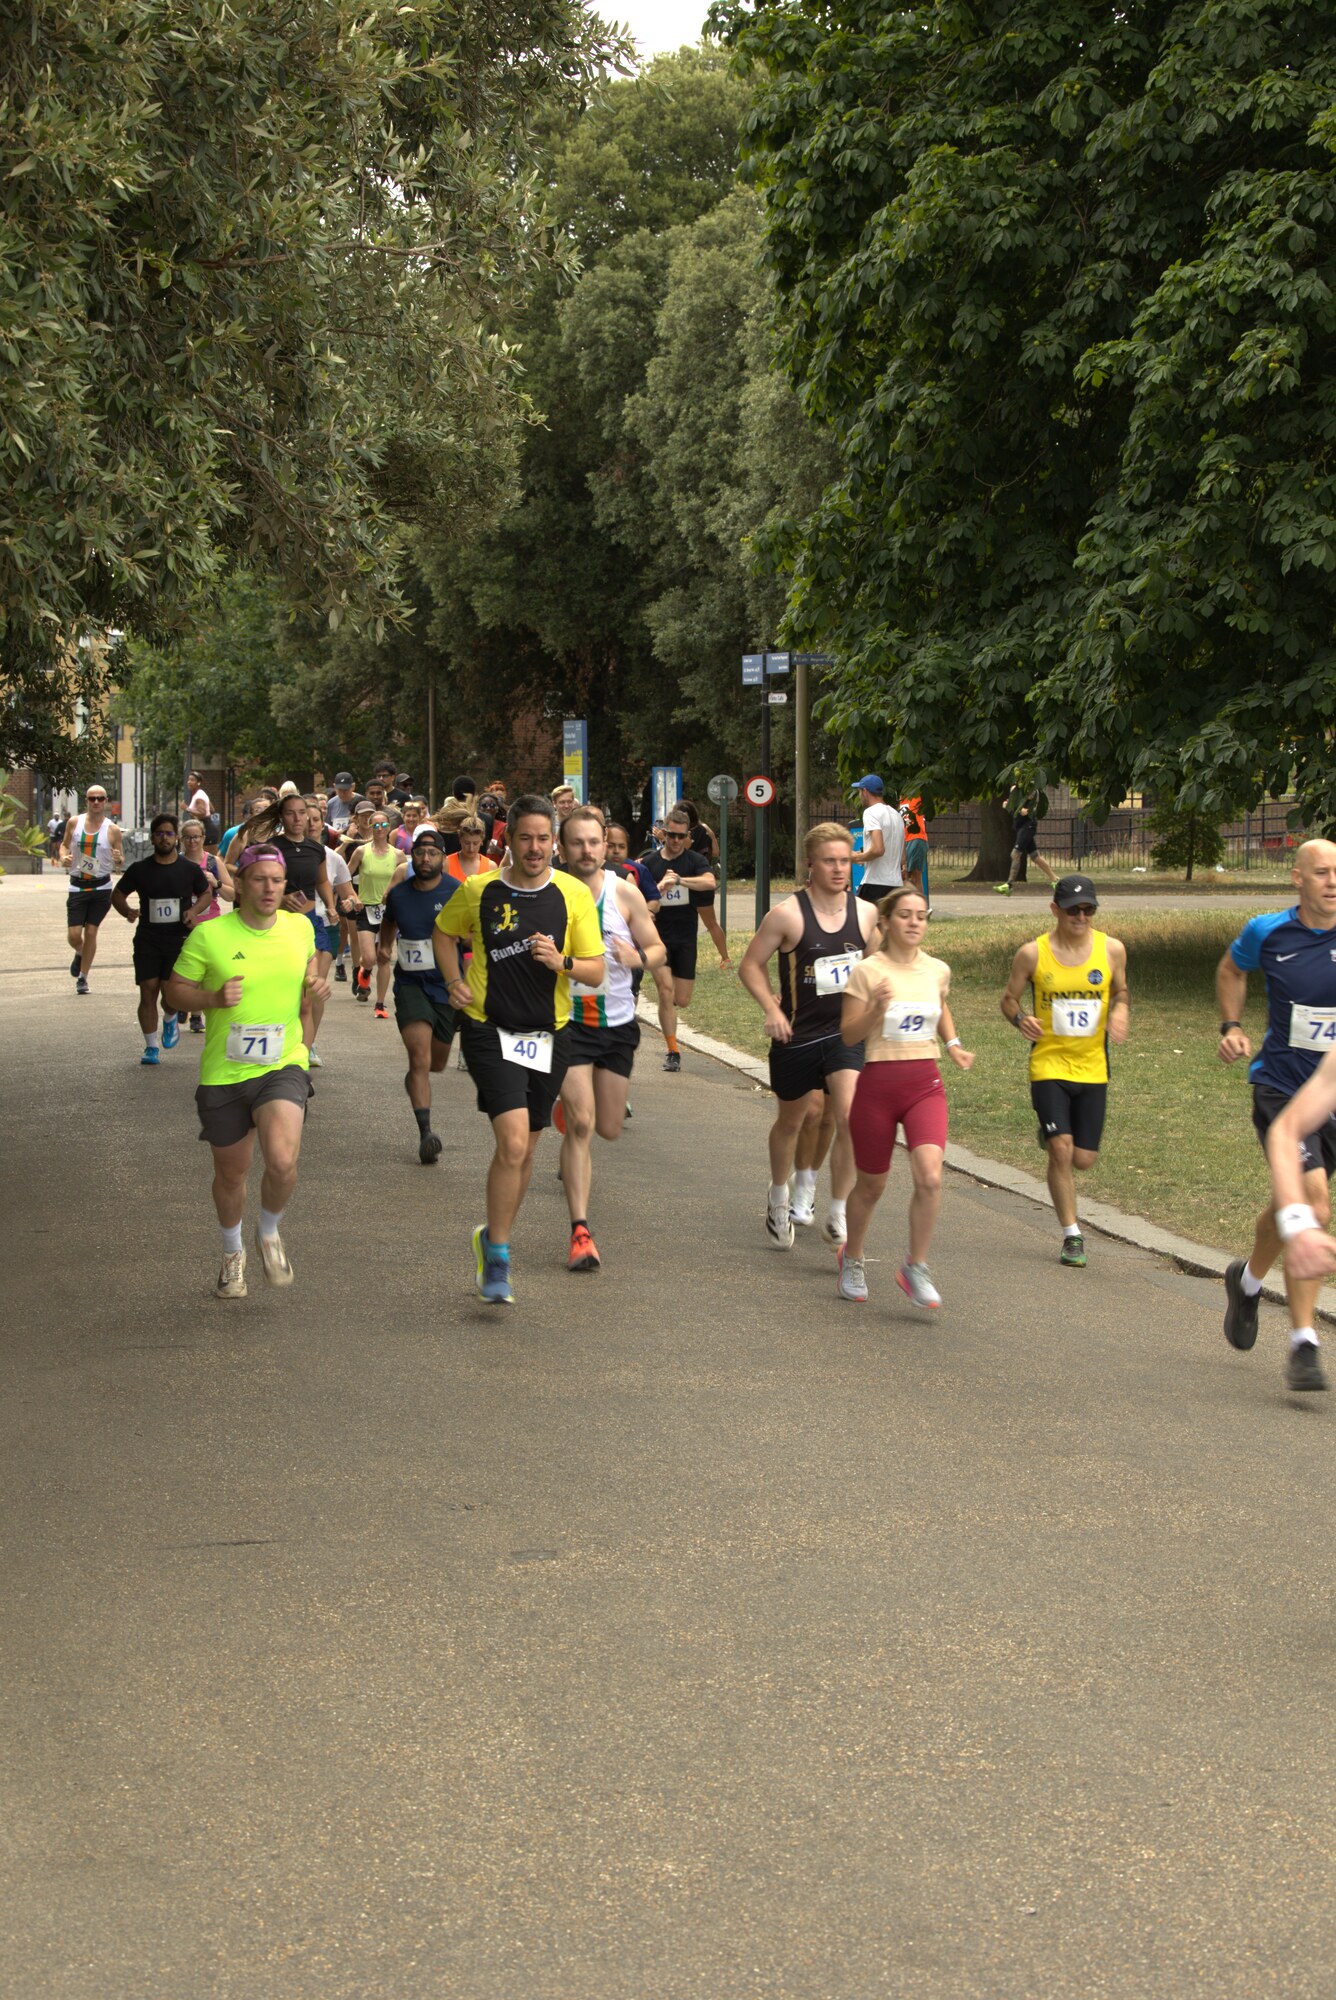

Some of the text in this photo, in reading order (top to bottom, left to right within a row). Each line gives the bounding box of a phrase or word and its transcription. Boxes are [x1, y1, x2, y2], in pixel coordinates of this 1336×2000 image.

[755, 785, 764, 797] 5
[82, 860, 94, 871] 79
[666, 890, 680, 900] 64
[157, 905, 171, 917] 10
[405, 949, 423, 963] 12
[490, 934, 555, 962] Run&Fe
[830, 965, 850, 984] 11
[899, 1015, 925, 1032] 49
[1066, 1011, 1088, 1027] 18
[1309, 1021, 1336, 1040] 74
[243, 1037, 267, 1055] 71
[513, 1040, 537, 1059] 40
